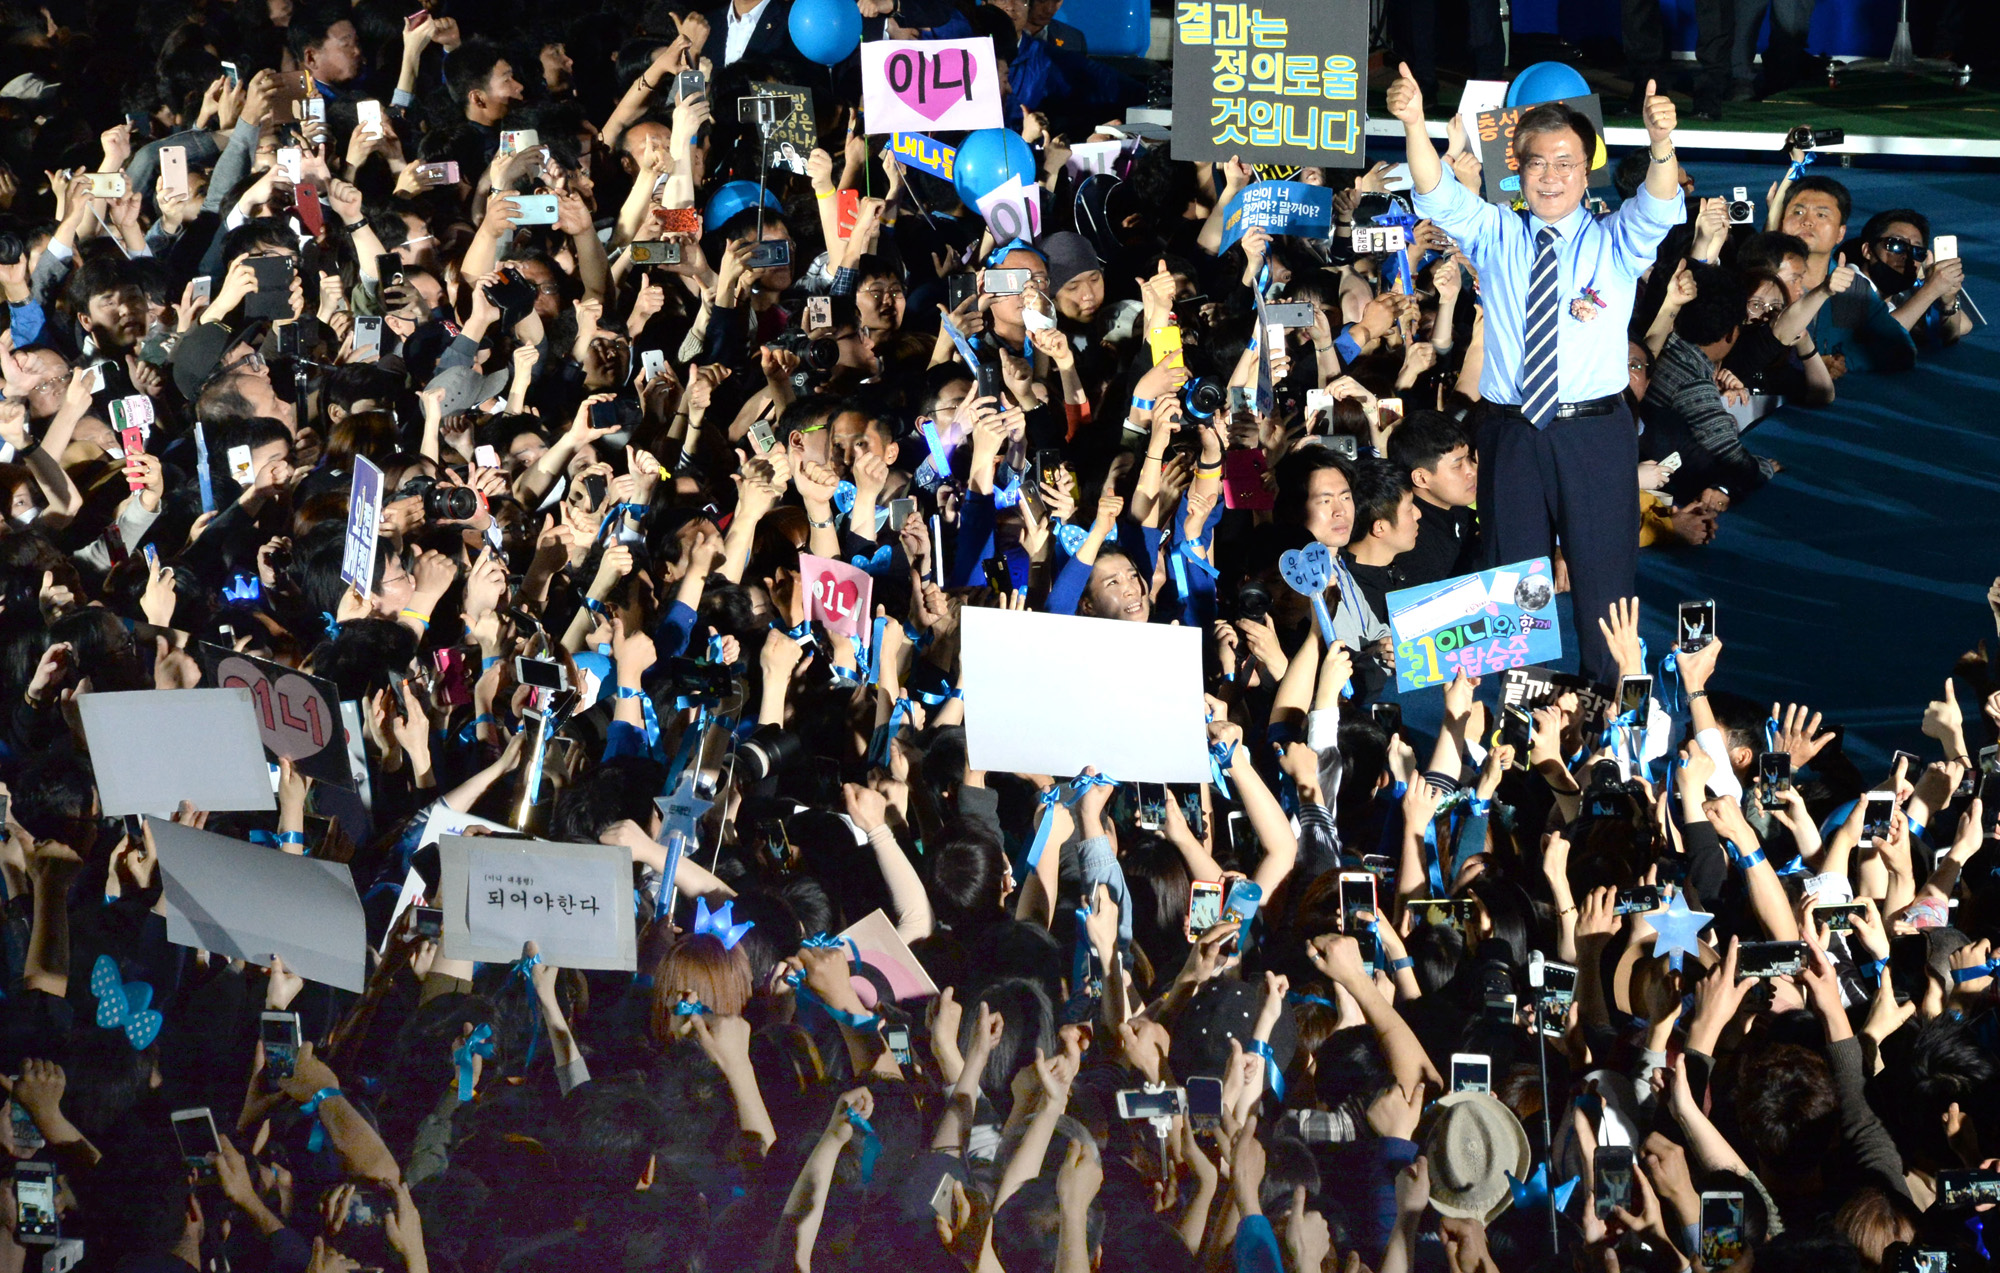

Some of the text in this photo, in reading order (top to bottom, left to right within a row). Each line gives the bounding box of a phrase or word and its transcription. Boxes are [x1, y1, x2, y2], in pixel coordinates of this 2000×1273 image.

[1177, 1, 1288, 48] 결과는
[889, 49, 973, 104] 이니
[1211, 49, 1359, 100] 정의로울
[1210, 97, 1361, 154] 것입니다
[1243, 187, 1289, 203] 재인이 너
[1279, 201, 1320, 218] 말꺼야?
[1356, 229, 1368, 252] 문재인
[1295, 563, 1325, 585] 이니
[1435, 613, 1552, 653] 이니와 함께
[1416, 635, 1444, 683] 1
[1459, 634, 1530, 676] 탑승중
